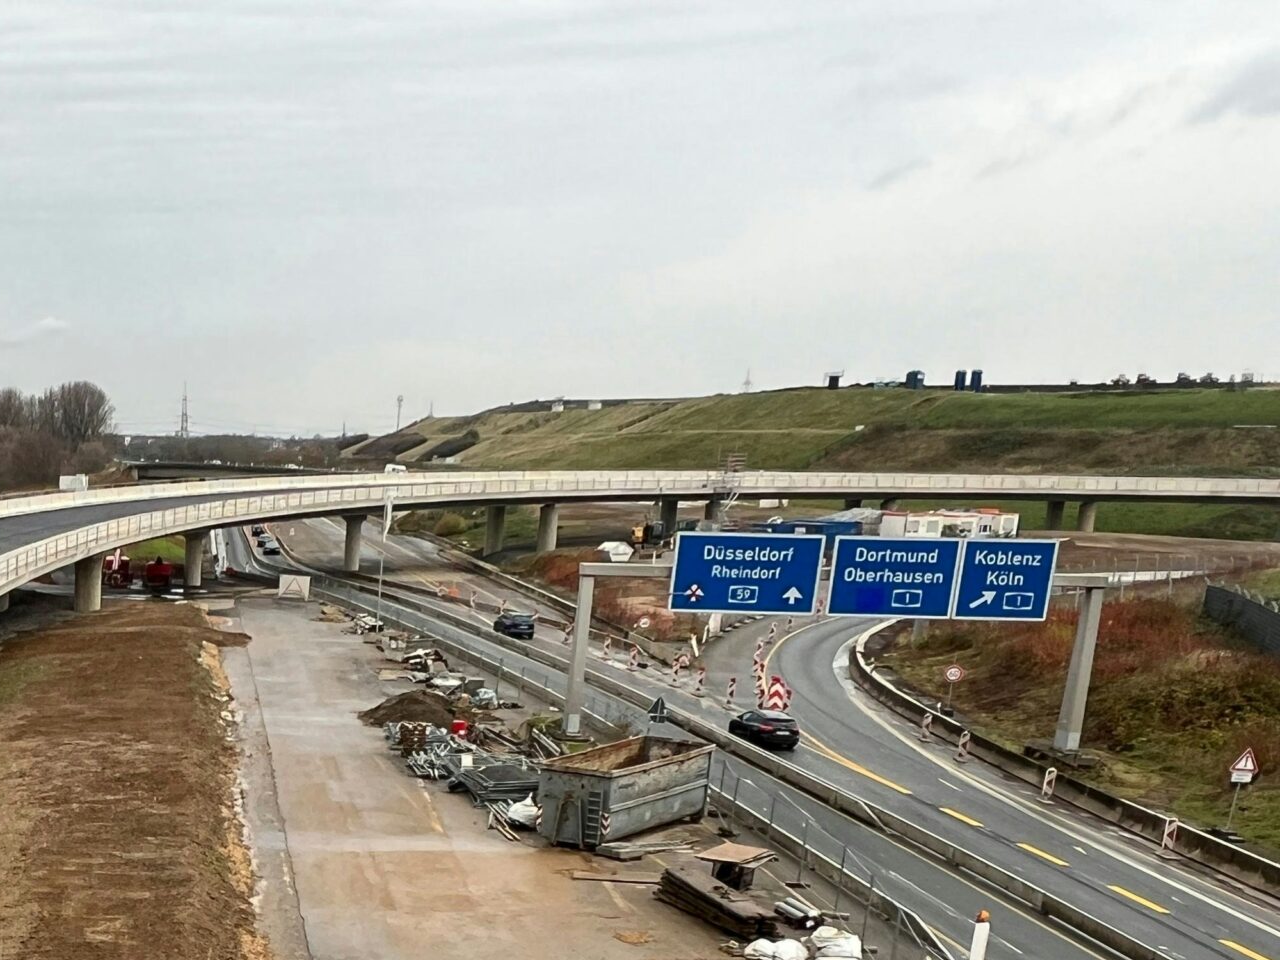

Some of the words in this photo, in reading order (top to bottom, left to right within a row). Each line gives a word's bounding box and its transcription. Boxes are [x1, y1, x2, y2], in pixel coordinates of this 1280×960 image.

[703, 545, 794, 562] Düsseldorf
[855, 547, 939, 563] Dortmund
[974, 550, 1042, 566] Koblenz
[711, 565, 781, 579] Rheindorf
[844, 567, 943, 584] Oberhausen
[986, 571, 1024, 586] Köln
[736, 589, 751, 600] 59
